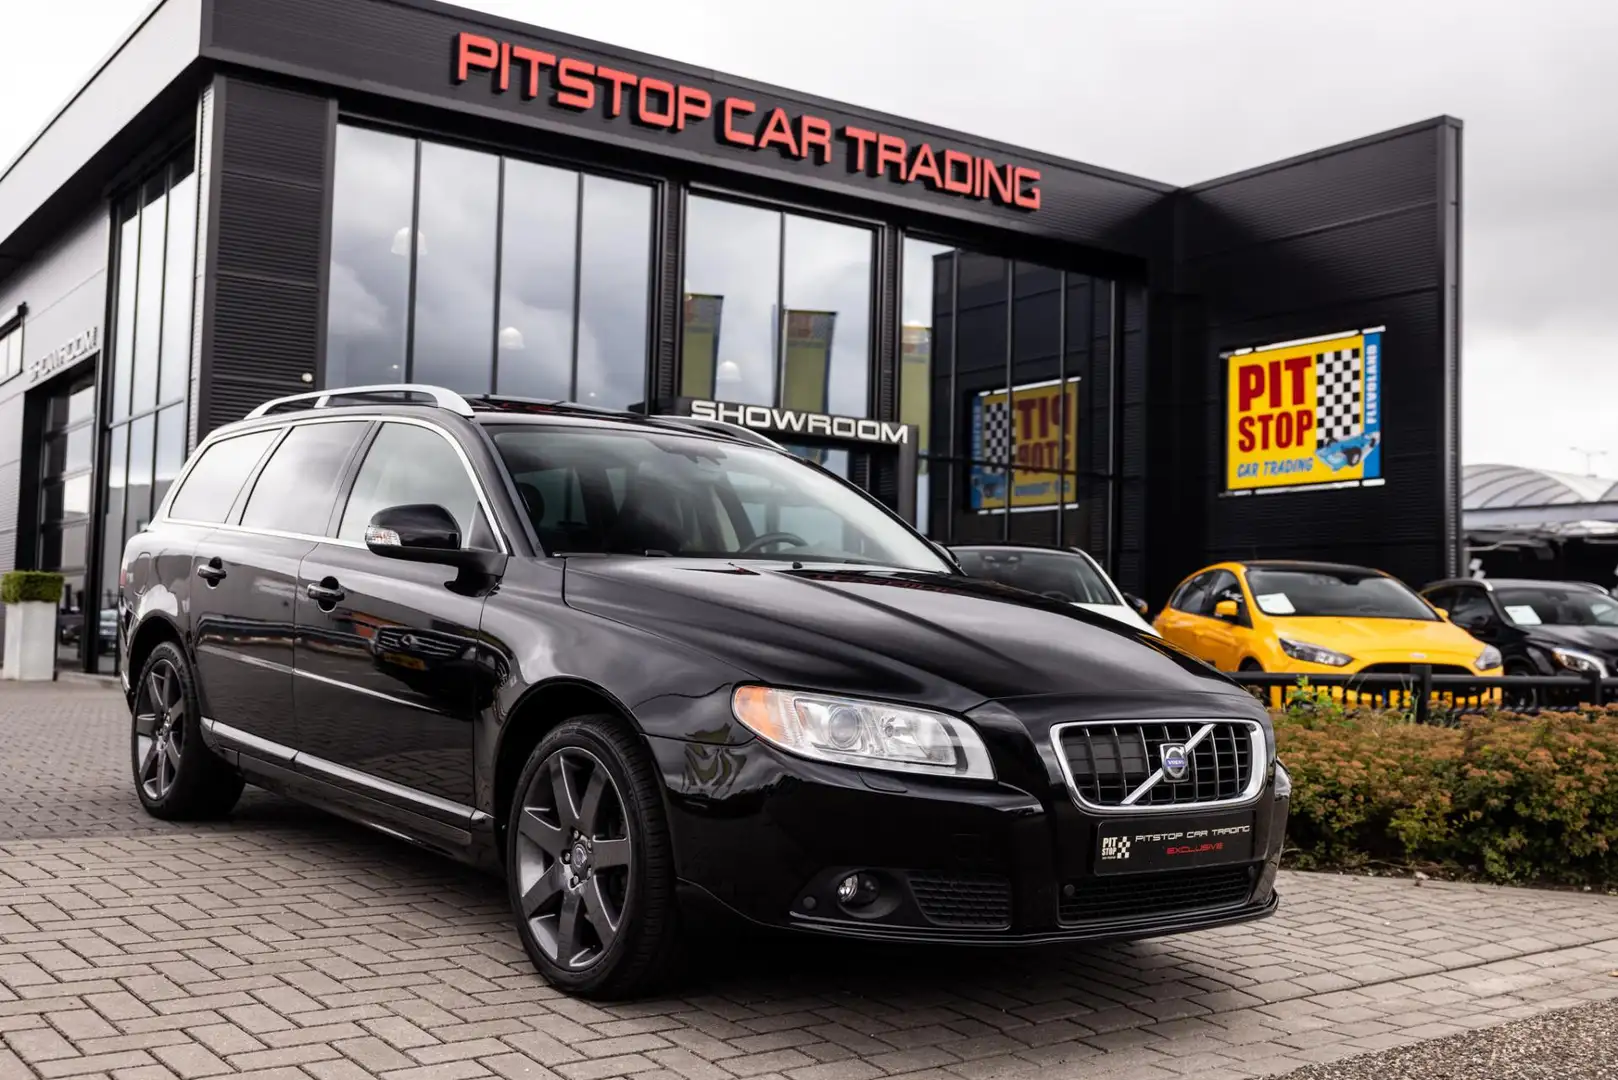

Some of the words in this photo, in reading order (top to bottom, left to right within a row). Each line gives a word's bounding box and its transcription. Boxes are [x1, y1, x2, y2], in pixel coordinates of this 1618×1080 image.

[456, 31, 712, 130] PITSTOP
[721, 97, 832, 163] CAR
[844, 125, 1041, 211] TRADING
[1238, 355, 1312, 413] PIT
[691, 400, 909, 444] SHOWROOM
[1238, 409, 1314, 453] STOP
[1237, 462, 1259, 479] CAR
[1263, 457, 1314, 477] TRADING
[1103, 837, 1118, 847] PIT
[1135, 832, 1183, 842] PITSTOP
[1186, 829, 1209, 839] CAR
[1102, 847, 1117, 856] STOP
[1167, 842, 1224, 854] EXCLUSIVE
